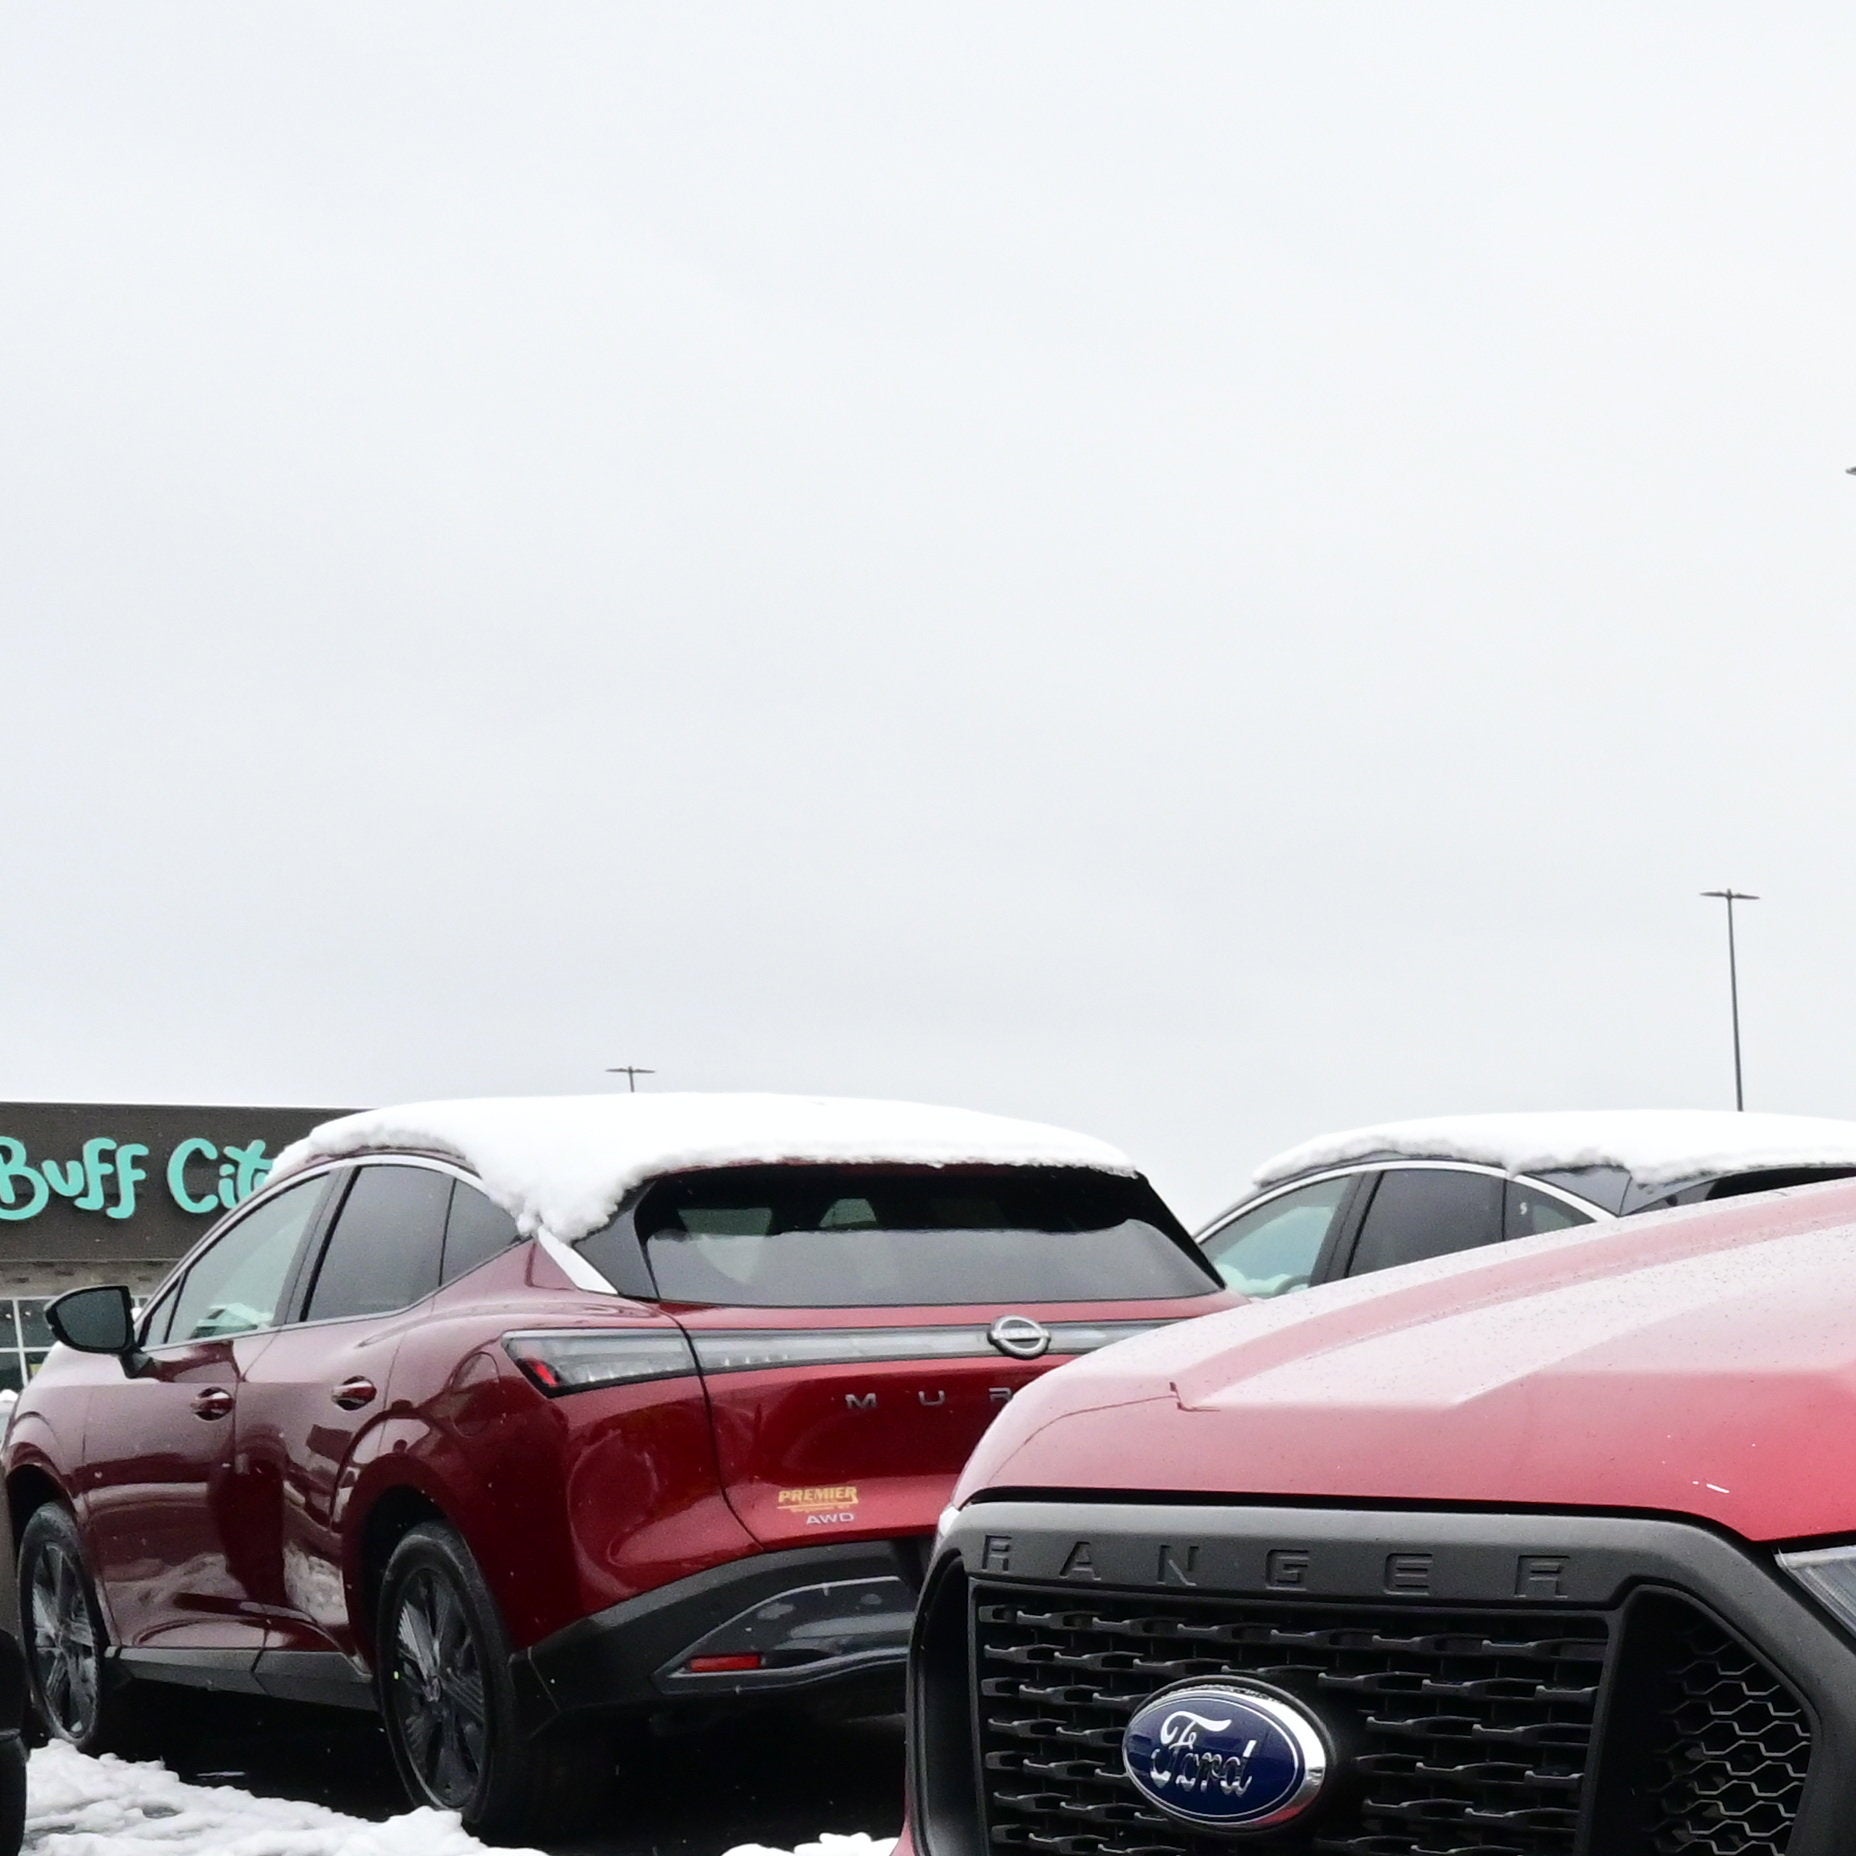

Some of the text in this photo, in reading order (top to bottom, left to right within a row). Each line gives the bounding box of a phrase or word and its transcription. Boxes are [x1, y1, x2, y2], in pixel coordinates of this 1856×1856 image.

[778, 1486, 858, 1504] PREMIER
[806, 1512, 855, 1525] AWD
[980, 1534, 1570, 1598] RANGER
[1148, 1710, 1254, 1796] Ford
